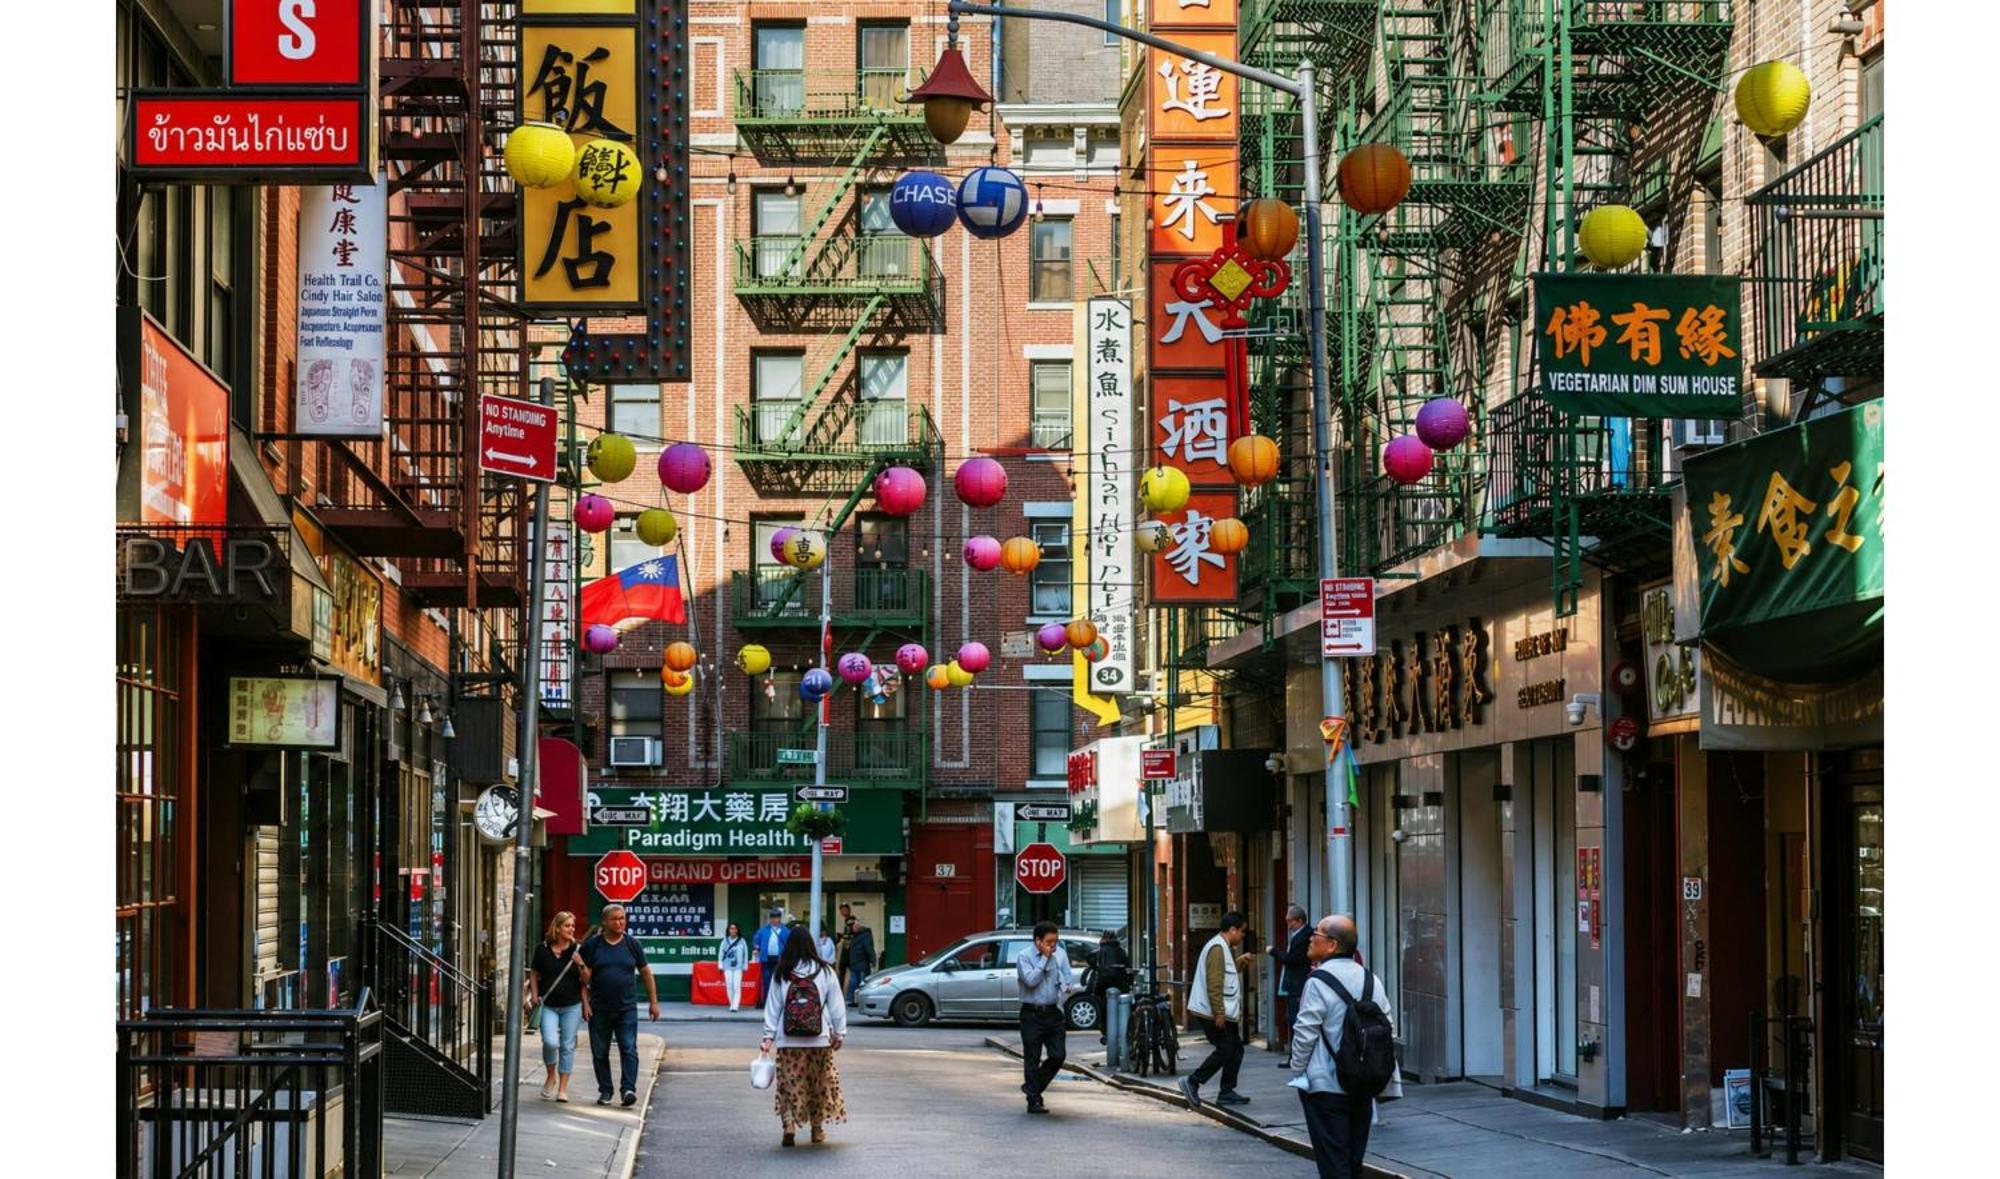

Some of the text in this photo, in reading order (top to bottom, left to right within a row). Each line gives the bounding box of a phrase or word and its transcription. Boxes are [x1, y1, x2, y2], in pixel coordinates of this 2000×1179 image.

[893, 184, 956, 207] CHASE
[304, 273, 336, 286] Health
[340, 273, 362, 286] Trail
[301, 289, 329, 304] Cindy
[333, 290, 353, 301] Hair
[1545, 301, 1737, 367] 佛有緣
[1095, 308, 1125, 398] 水煮魚
[1549, 371, 1737, 395] VEGETARIAN DIM SUM HOUSE
[486, 403, 547, 428] NO STANDING
[486, 420, 526, 440] Anytime
[125, 537, 277, 596] BAR
[1101, 669, 1118, 682] 34
[628, 829, 721, 850] Paradigm
[729, 829, 794, 846] Health
[599, 867, 642, 886] STOP
[651, 861, 801, 880] GRAND OPENING
[938, 866, 953, 877] 37
[1019, 858, 1061, 877] STOP
[1685, 881, 1700, 898] 39
